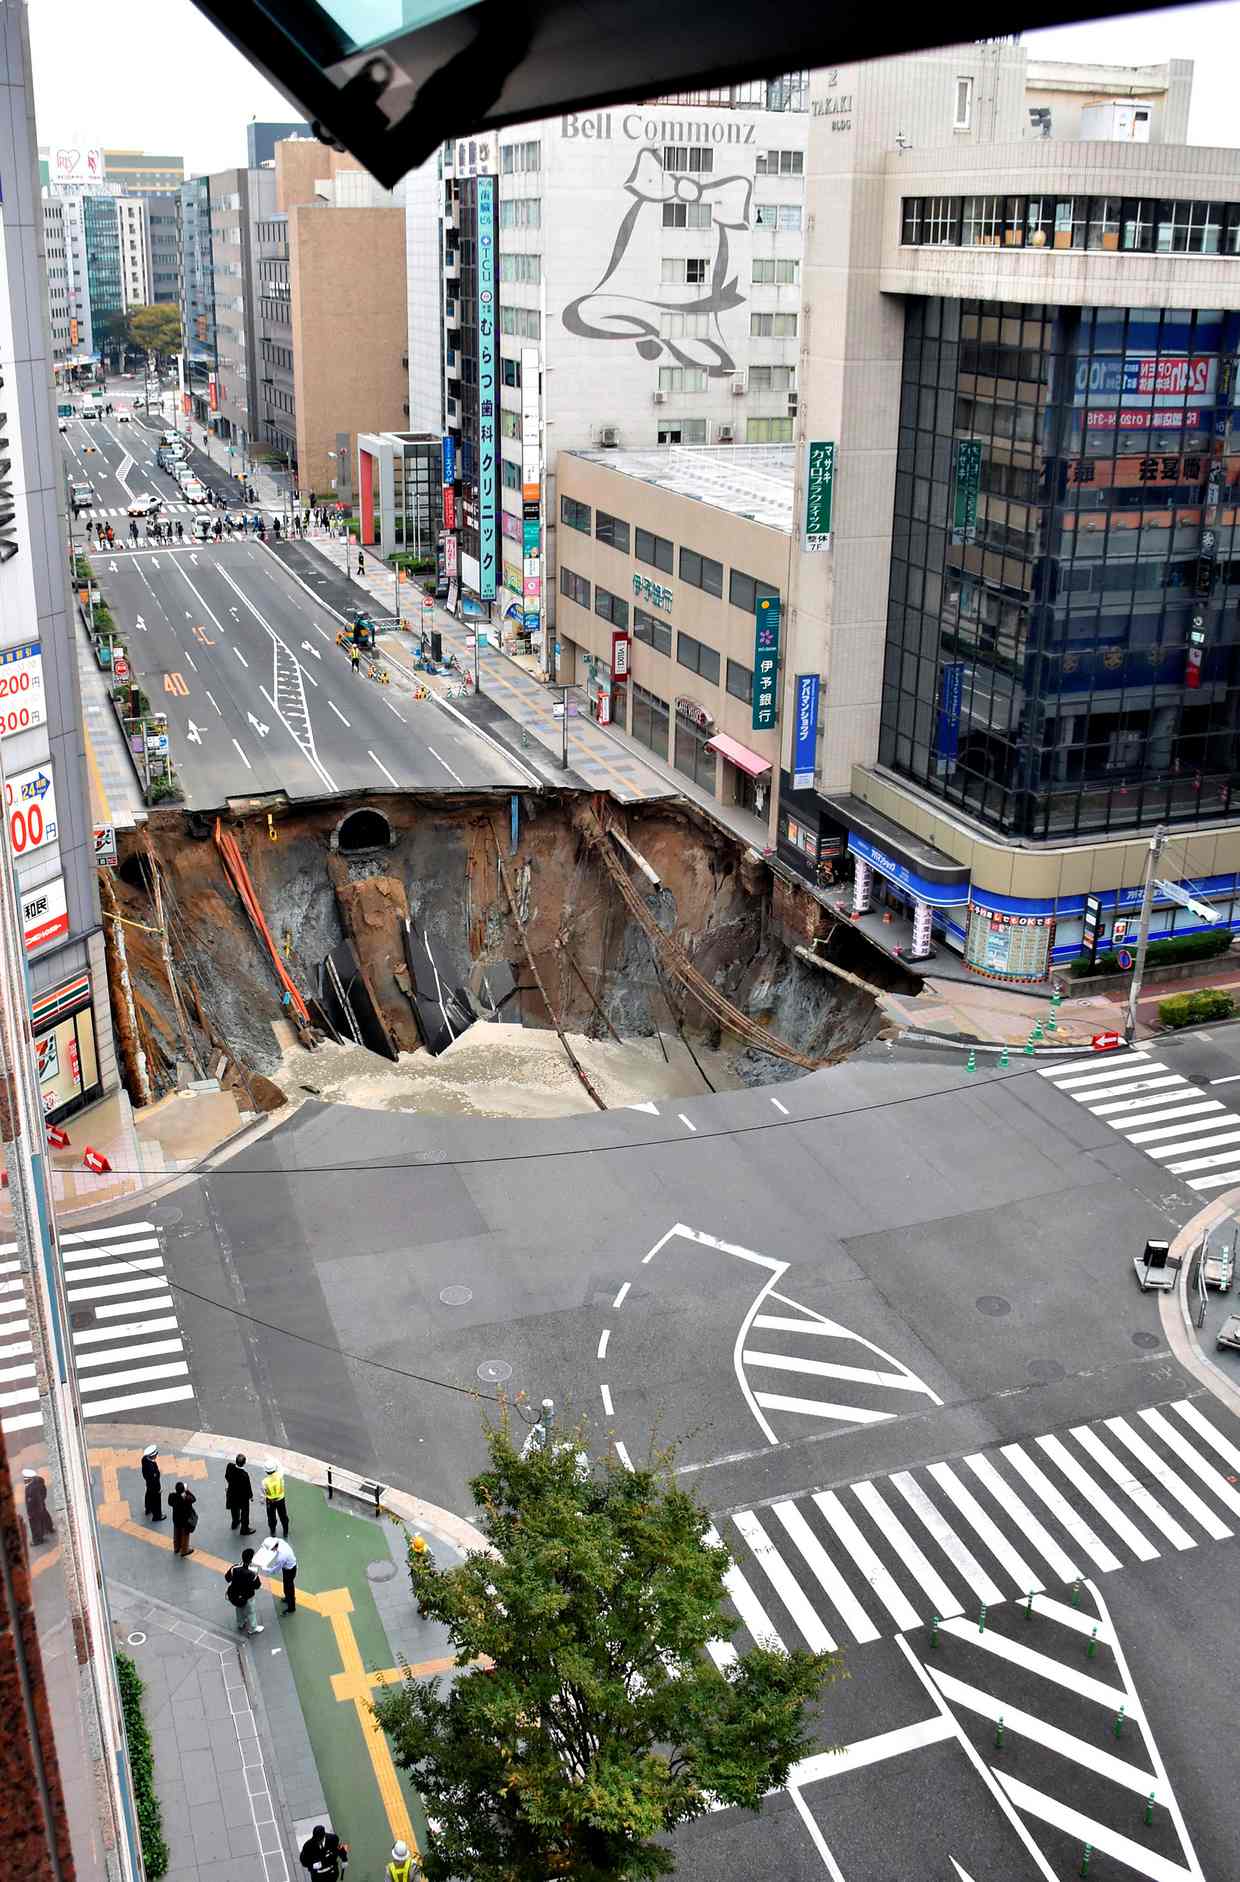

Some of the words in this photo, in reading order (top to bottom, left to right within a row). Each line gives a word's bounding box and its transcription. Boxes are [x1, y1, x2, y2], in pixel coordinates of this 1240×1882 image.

[811, 96, 852, 116] TAKAKI
[561, 113, 612, 139] Bell
[622, 114, 756, 144] Commonz
[480, 318, 493, 570] むらつ歯科クリニック
[823, 446, 833, 484] マサキ
[759, 660, 774, 723] 伊予銀行
[24, 896, 48, 919] 和民
